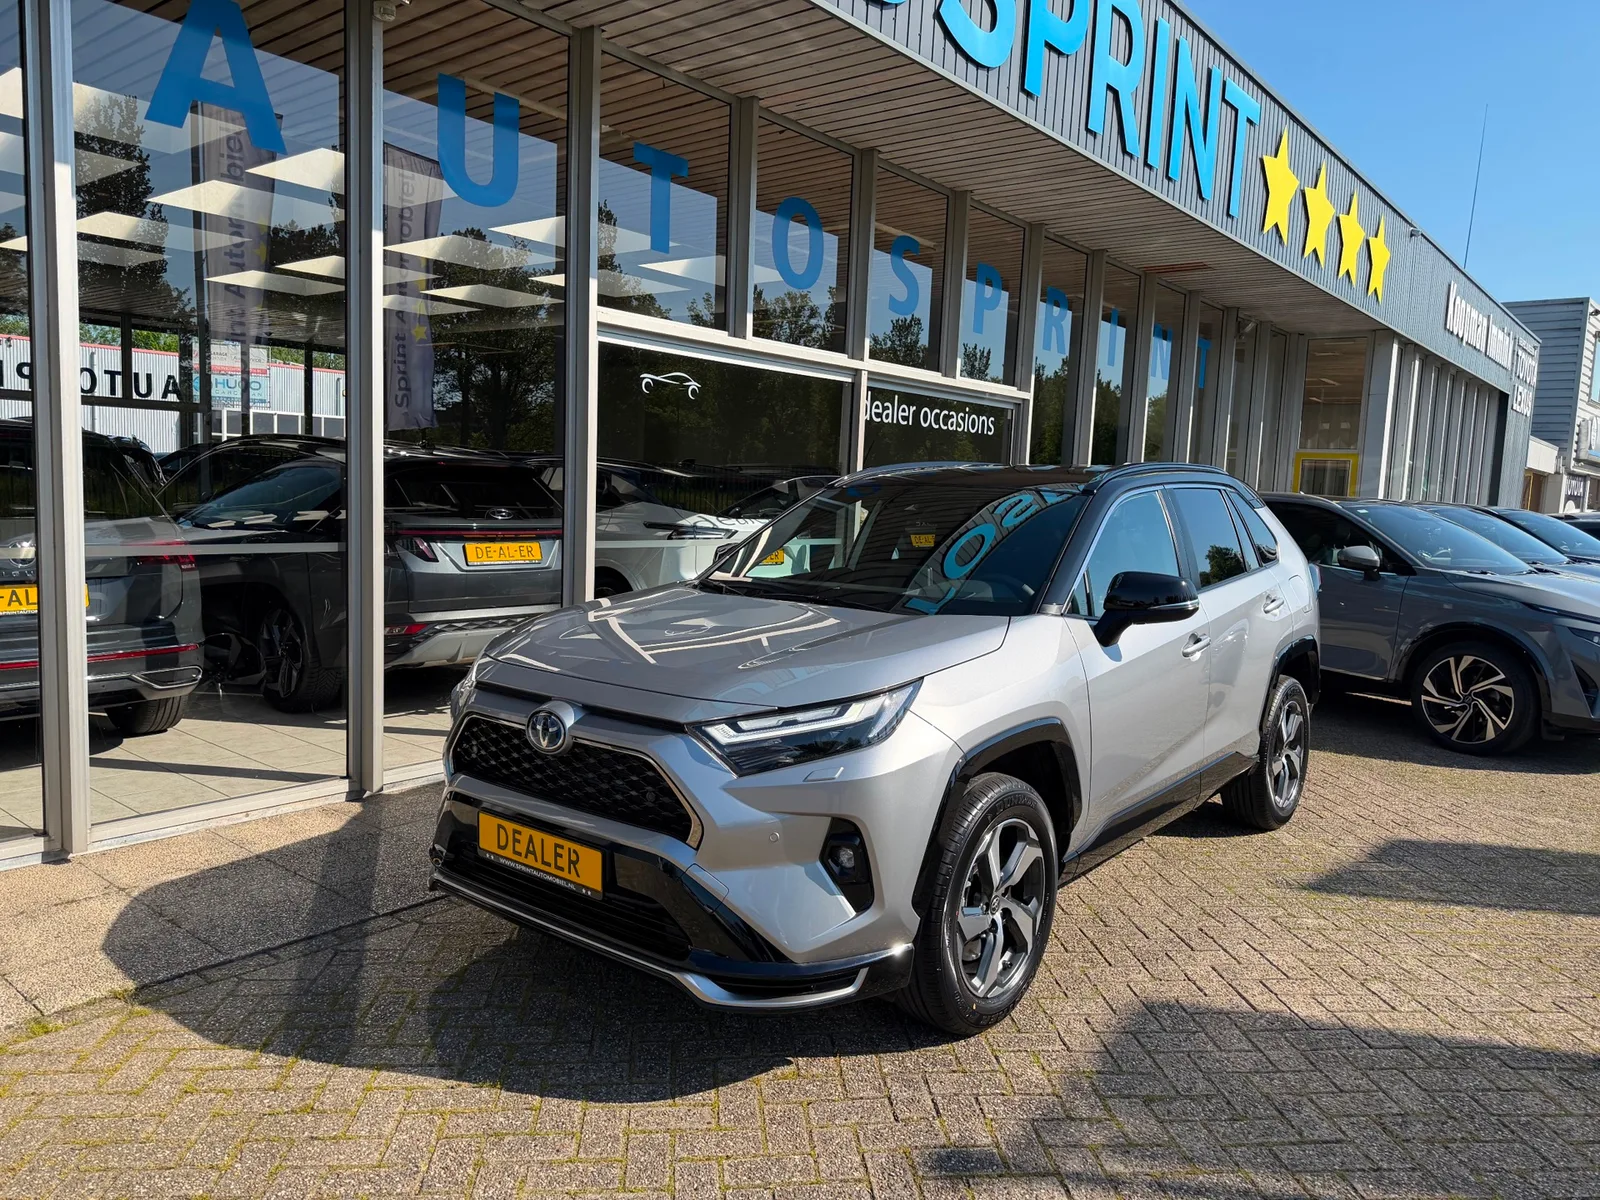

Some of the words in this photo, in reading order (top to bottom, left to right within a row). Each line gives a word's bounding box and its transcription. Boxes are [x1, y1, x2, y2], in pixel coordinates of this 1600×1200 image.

[1446, 280, 1488, 353] Koopman
[395, 333, 411, 408] Sprint
[1516, 350, 1538, 388] TOYOTA
[865, 391, 916, 426] dealer
[920, 406, 995, 436] occasions
[1512, 384, 1533, 417] LEXUS
[475, 545, 535, 560] DE-AL-ER
[496, 823, 580, 878] DEALER
